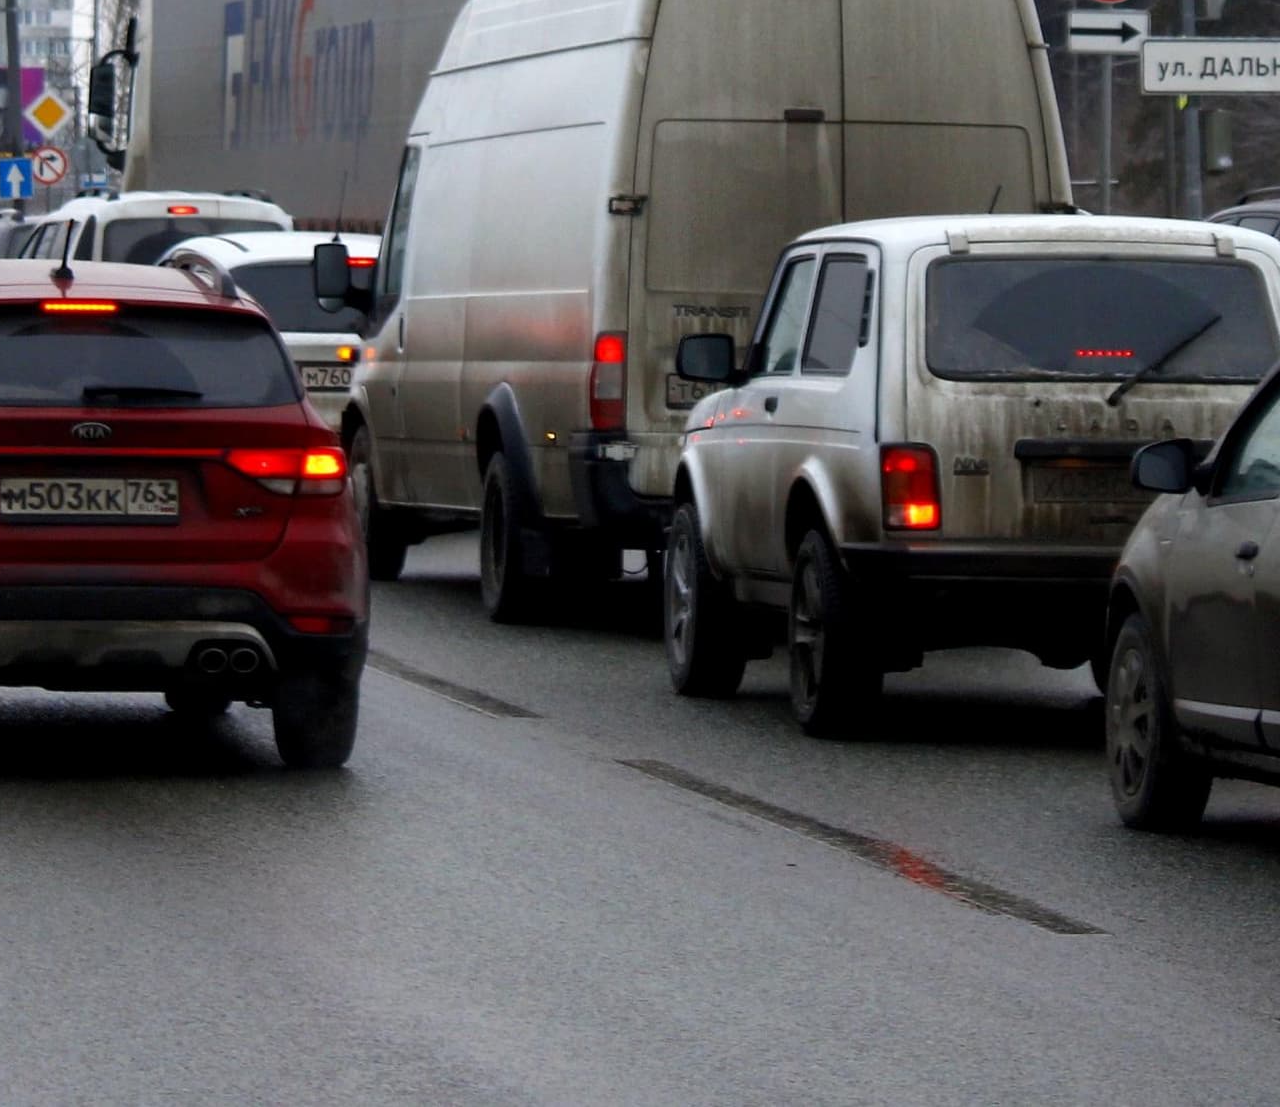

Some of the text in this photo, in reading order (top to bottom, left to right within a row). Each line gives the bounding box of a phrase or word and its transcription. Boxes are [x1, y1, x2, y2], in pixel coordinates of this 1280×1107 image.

[1158, 61, 1193, 82] ул.
[306, 368, 352, 385] М760
[77, 426, 106, 440] KIA
